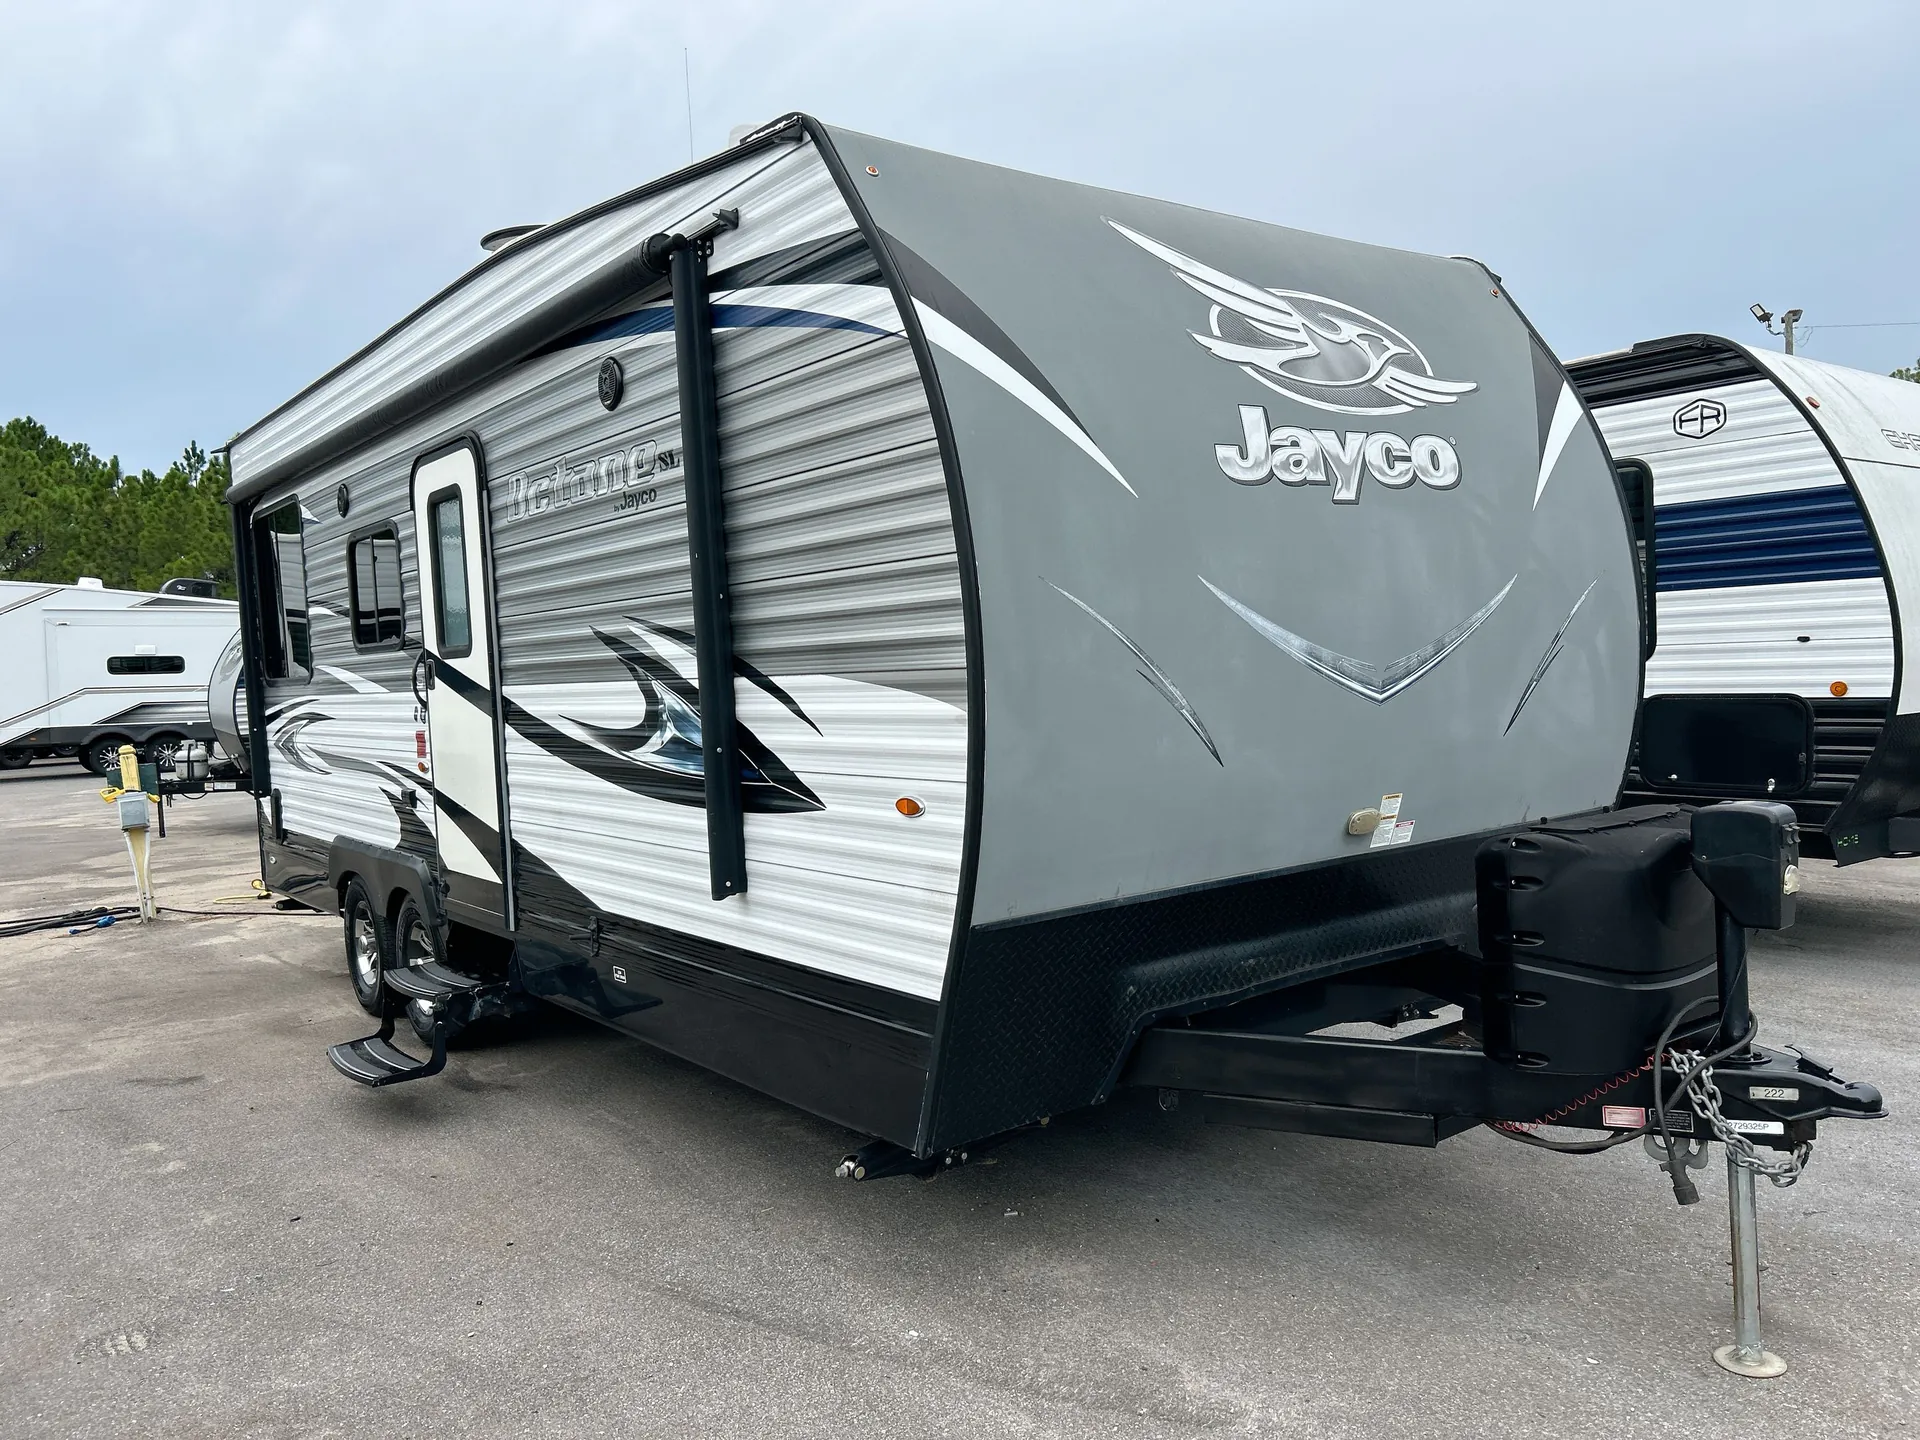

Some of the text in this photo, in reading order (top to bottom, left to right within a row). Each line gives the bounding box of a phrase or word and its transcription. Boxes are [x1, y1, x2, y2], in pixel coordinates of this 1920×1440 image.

[1213, 403, 1463, 505] Jayco
[506, 439, 658, 523] Octane
[620, 488, 657, 511] Jayco
[1763, 1088, 1785, 1099] 222
